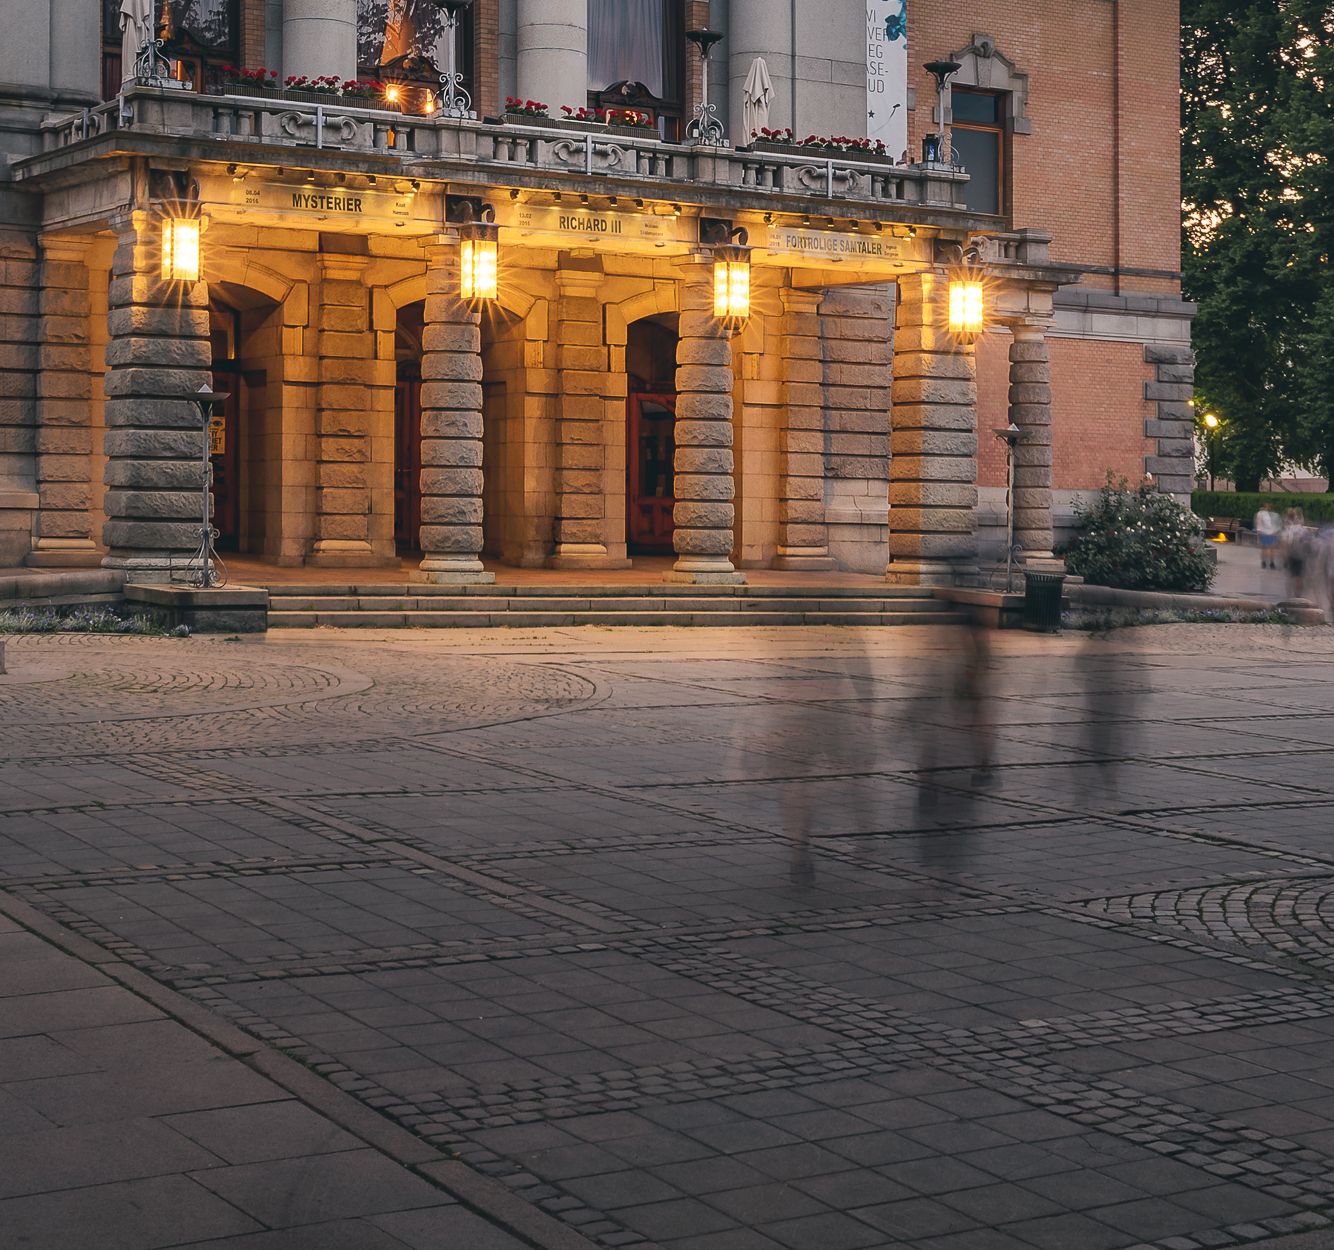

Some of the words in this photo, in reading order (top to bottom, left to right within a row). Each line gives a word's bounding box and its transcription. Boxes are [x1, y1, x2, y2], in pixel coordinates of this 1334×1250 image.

[867, 61, 889, 77] SE-
[292, 193, 363, 213] MYSTERIER
[559, 216, 607, 232] RICHARD
[611, 220, 622, 234] III
[786, 235, 838, 252] FORTROLIGE
[839, 239, 883, 256] SAMTALER
